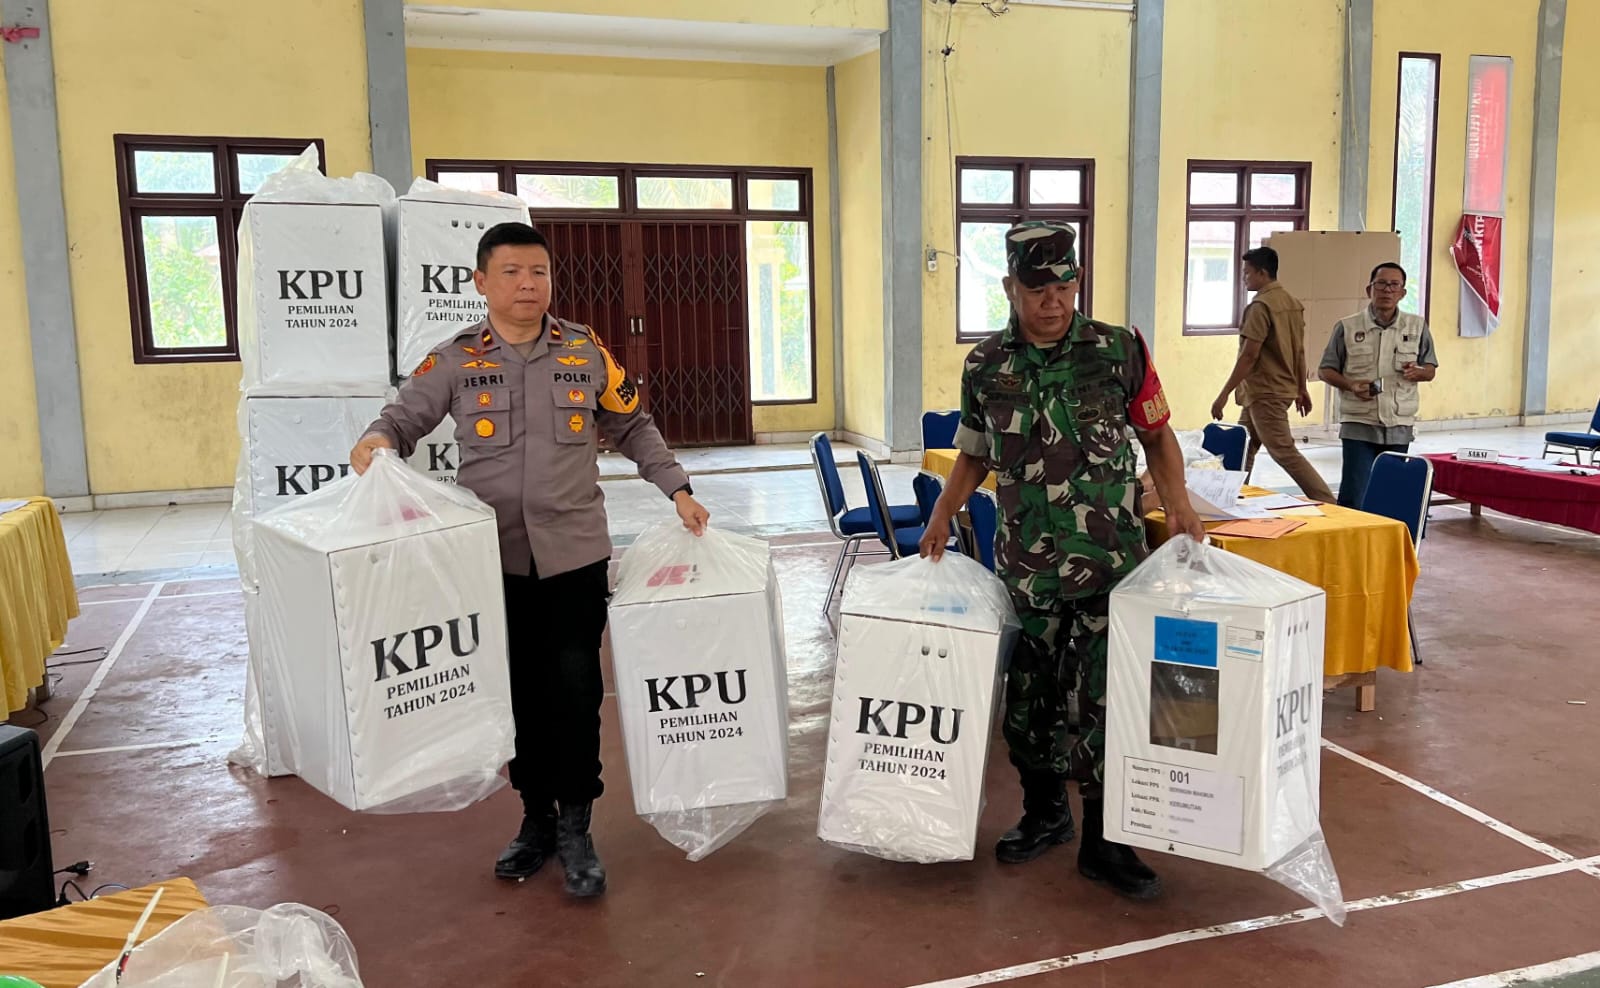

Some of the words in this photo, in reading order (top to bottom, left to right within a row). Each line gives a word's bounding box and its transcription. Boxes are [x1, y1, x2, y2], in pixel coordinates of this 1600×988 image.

[277, 270, 364, 300] KPU
[421, 264, 474, 294] KP
[287, 305, 354, 315] PEMILIHAN
[426, 311, 463, 322] TAHUN
[466, 313, 487, 322] 202
[285, 319, 326, 328] TAHUN
[329, 318, 358, 328] 2024
[463, 374, 504, 388] JERRI
[554, 372, 591, 384] POLRI
[370, 612, 480, 682] KPU
[387, 663, 470, 699] PEMILIHAN
[644, 669, 747, 713] KPU
[384, 693, 436, 719] TAHUN
[439, 681, 475, 702] 2024
[659, 711, 738, 729] PEMILIHAN
[855, 696, 965, 745] KPU
[1275, 682, 1313, 740] KPU
[658, 730, 706, 745] TAHUN
[708, 726, 743, 740] 2024
[863, 742, 945, 763] PEMILIHAN
[858, 758, 907, 775] TAHUN
[910, 765, 947, 780] 2024
[1169, 769, 1189, 785] 001
